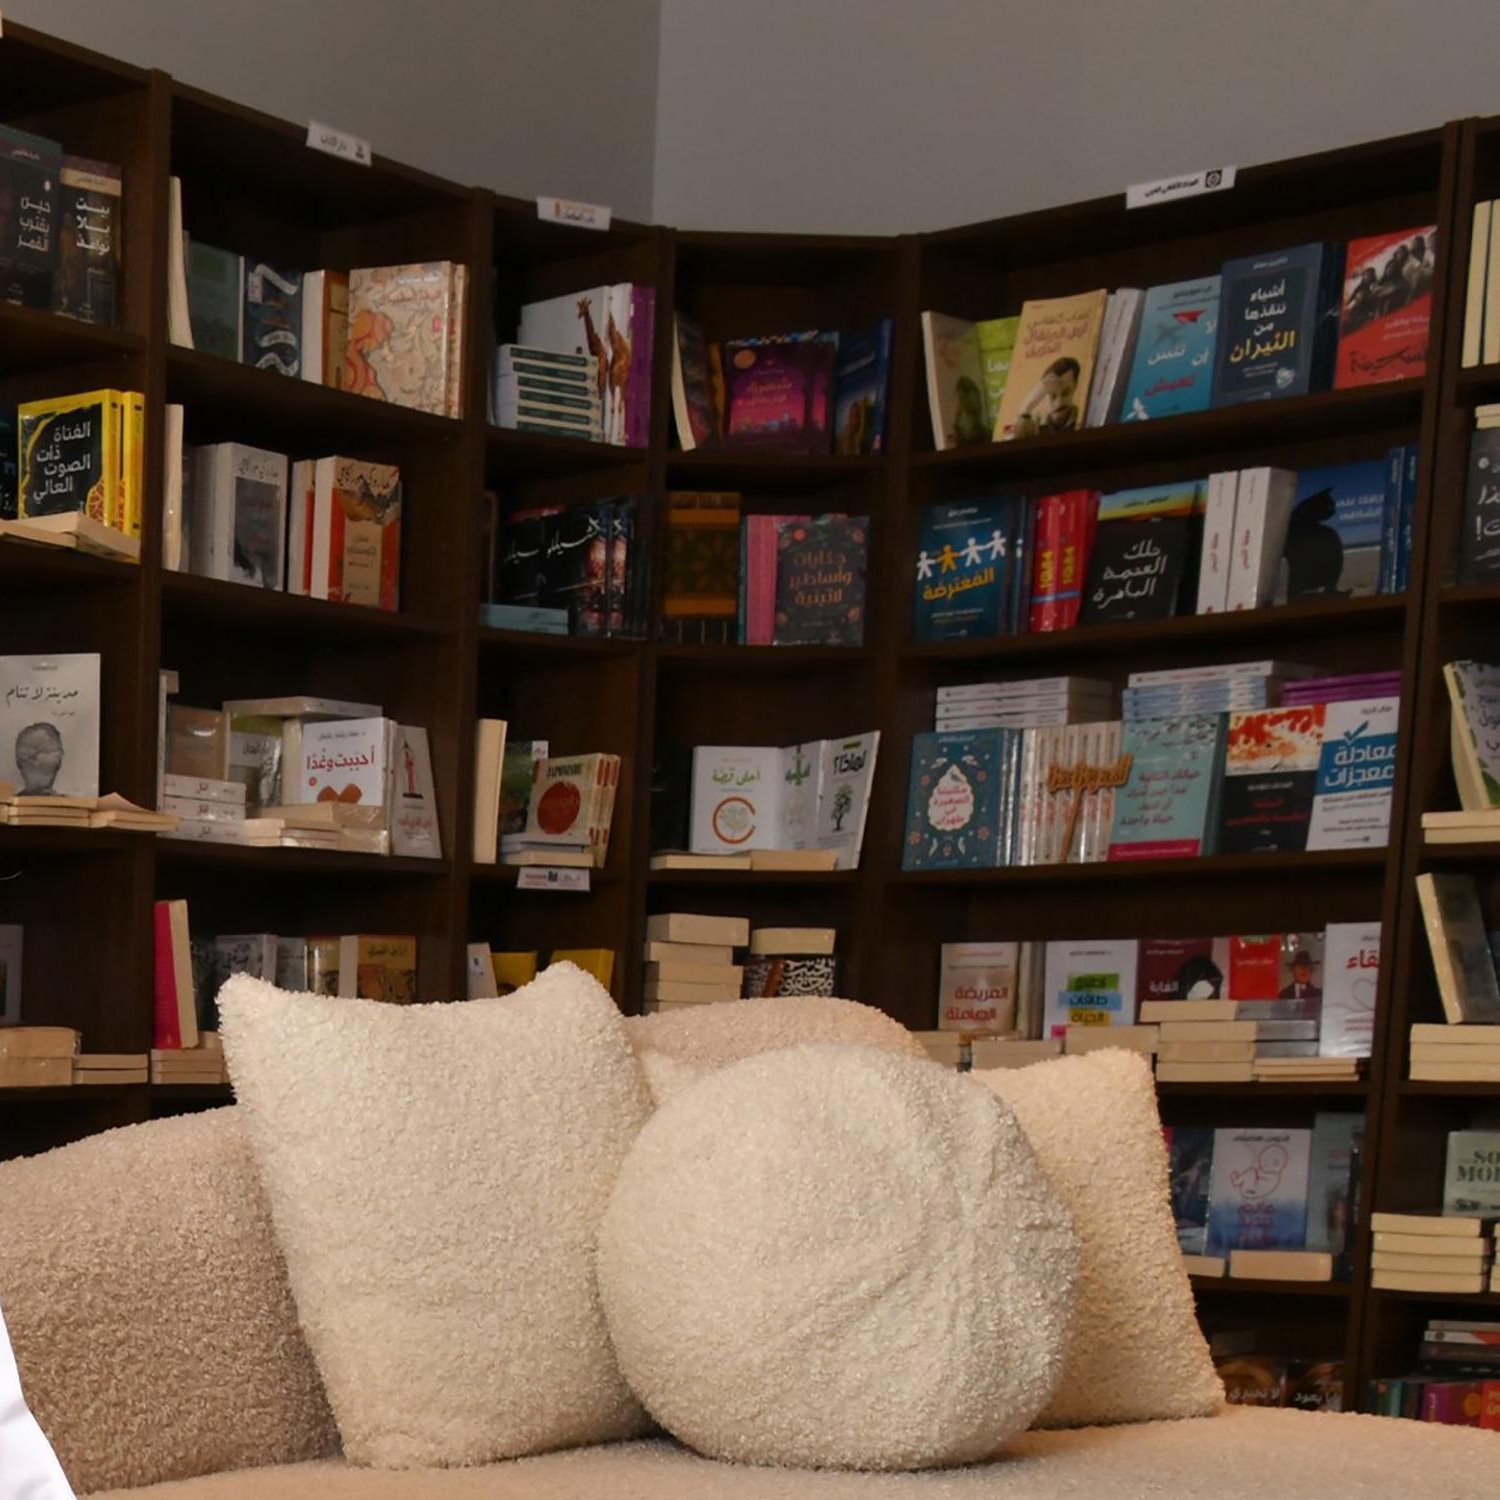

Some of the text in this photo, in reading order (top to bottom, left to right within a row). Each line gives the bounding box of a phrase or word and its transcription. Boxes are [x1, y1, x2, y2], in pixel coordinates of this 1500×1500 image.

[20, 196, 51, 213] حين
[75, 196, 110, 214] بيت
[19, 216, 50, 235] يقترب
[75, 216, 110, 235] بلا
[17, 235, 49, 253] القمر
[75, 238, 110, 256] نوافذ
[1250, 279, 1285, 302] أشياء
[1253, 321, 1274, 336] من
[1229, 330, 1297, 363] النيران
[53, 421, 91, 442] الفتاة
[36, 442, 61, 462] ذات
[43, 454, 91, 478] الصوت
[32, 475, 73, 504] العالي
[5, 685, 79, 708] مدينة لا تنام
